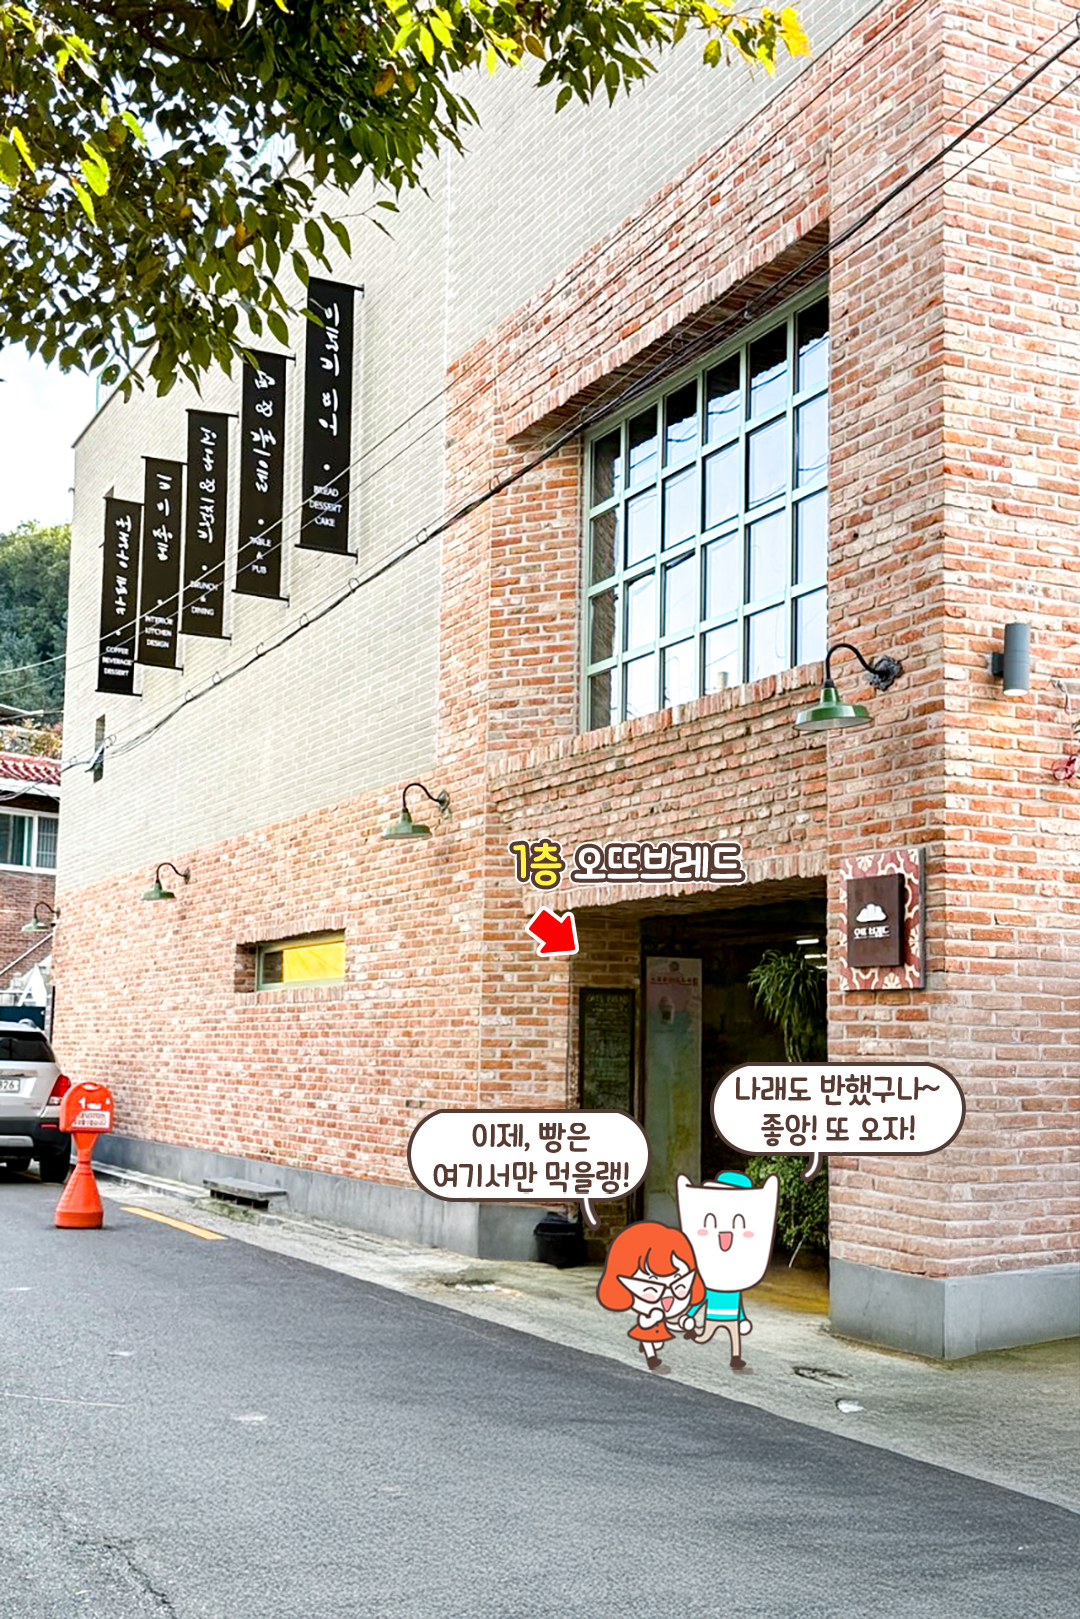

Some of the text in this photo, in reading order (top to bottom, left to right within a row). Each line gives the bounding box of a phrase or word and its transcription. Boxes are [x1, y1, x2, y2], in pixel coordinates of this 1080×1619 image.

[318, 301, 341, 437] 오뜨 브레드
[255, 399, 274, 418] &
[250, 427, 277, 493] 테이블
[156, 473, 173, 491] 비
[196, 426, 218, 544] 브런치 & 다이닝
[313, 485, 339, 497] BREAD
[309, 499, 343, 514] DESSERT
[314, 516, 336, 528] CAKE
[249, 536, 272, 547] TABLE
[251, 564, 267, 575] PUB
[189, 580, 218, 592] BRUNCH
[114, 574, 129, 616] 카페
[191, 605, 215, 616] DINING
[144, 615, 174, 626] INTERIOR
[146, 638, 170, 649] DESIGN
[105, 645, 130, 656] COFFEE
[102, 656, 133, 667] BEVERAGE
[103, 667, 130, 677] DESSERT
